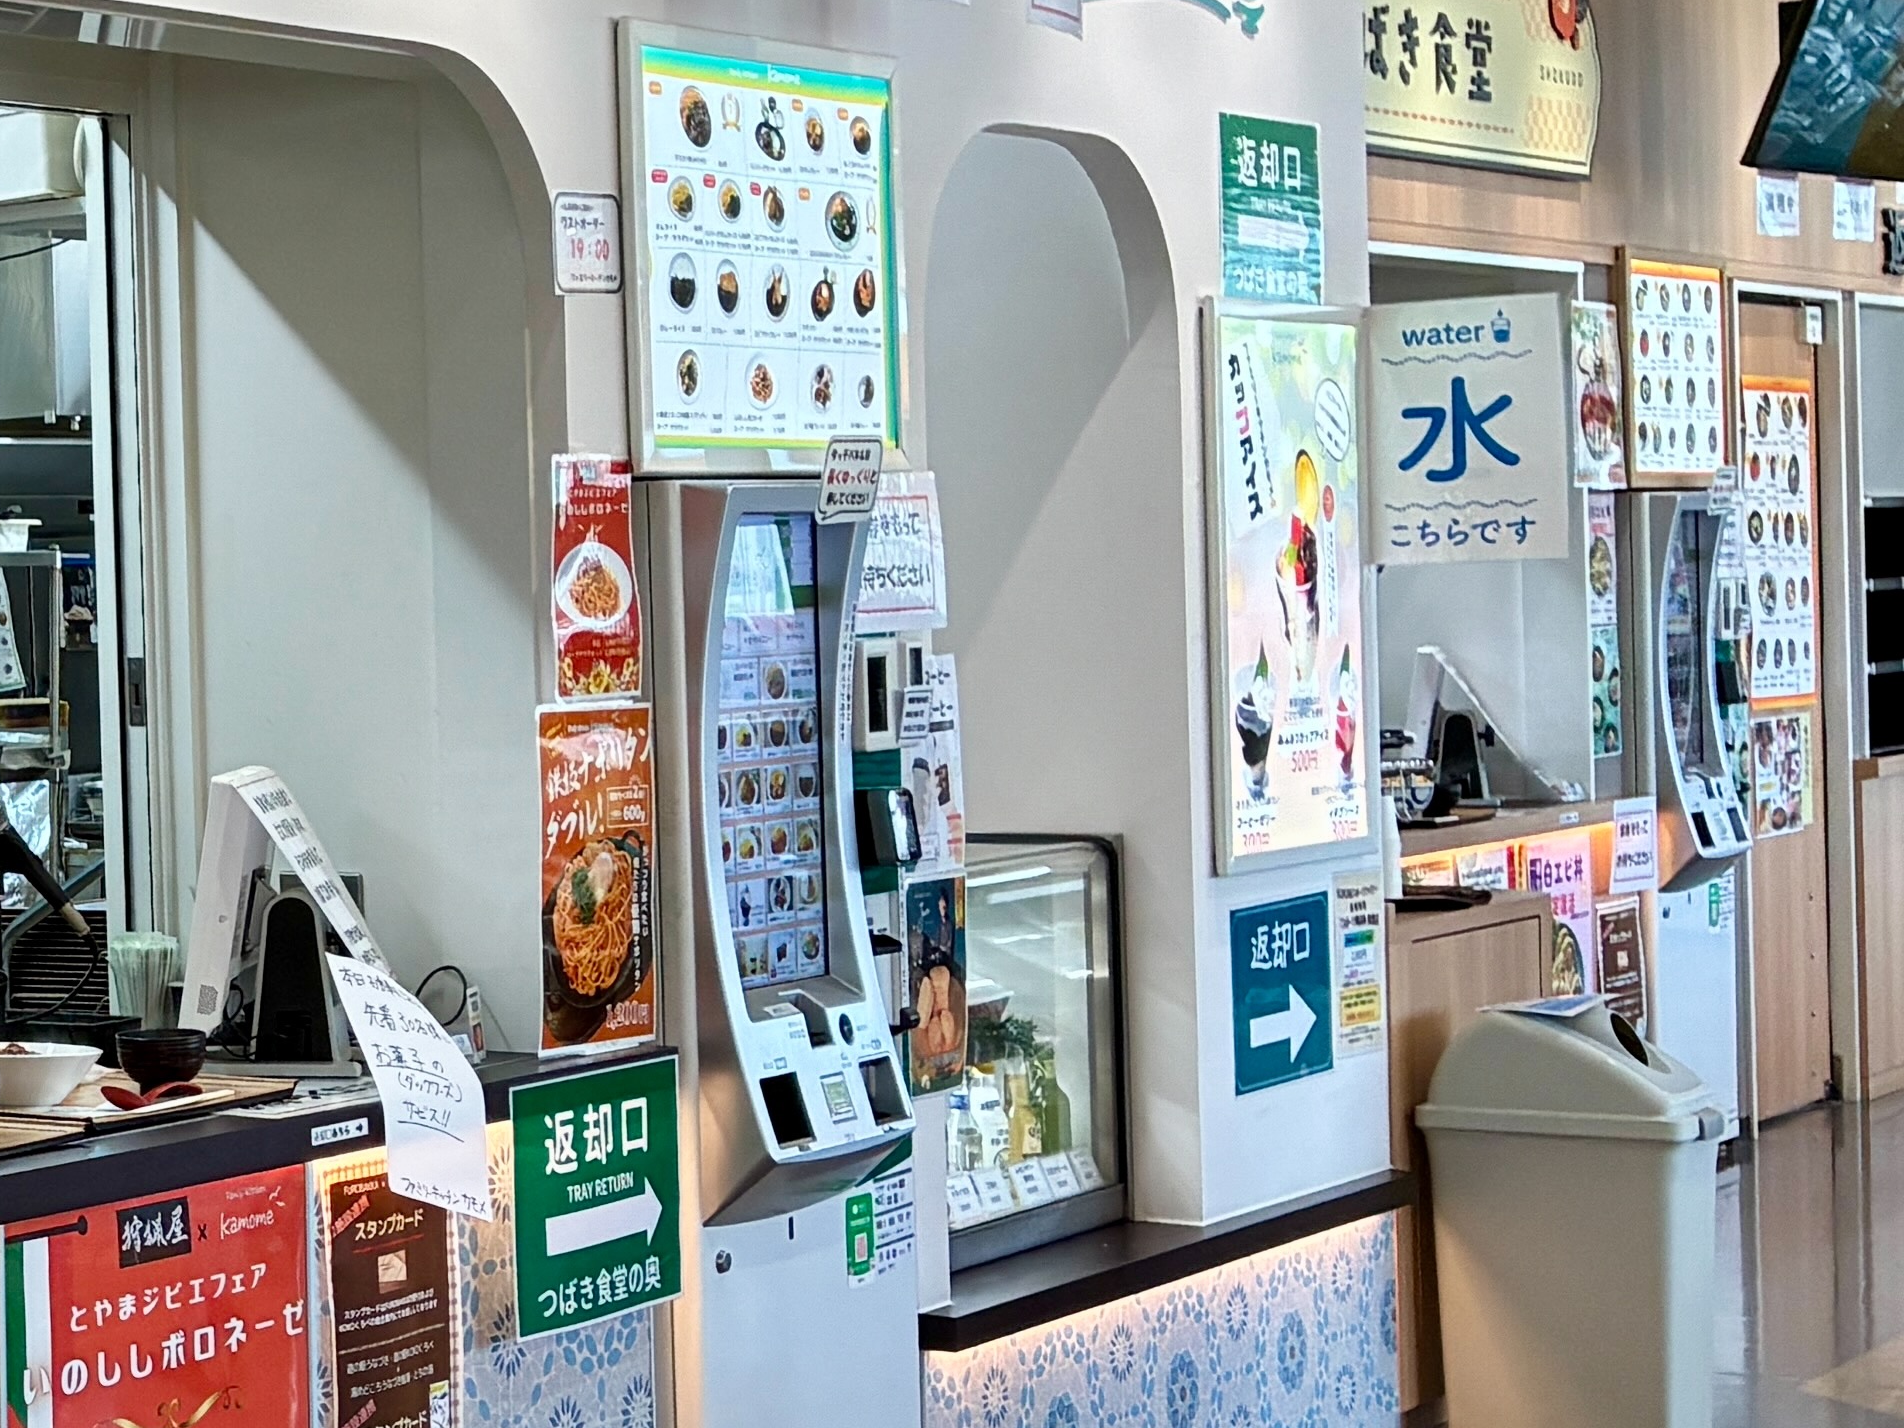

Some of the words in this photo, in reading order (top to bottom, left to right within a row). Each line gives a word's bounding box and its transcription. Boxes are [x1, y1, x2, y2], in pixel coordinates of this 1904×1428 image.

[1230, 135, 1301, 192] 返却口
[1401, 322, 1486, 348] water
[1399, 375, 1522, 483] 水
[1390, 515, 1537, 547] こちらです
[1250, 921, 1310, 969] 返却口
[543, 1094, 649, 1171] 返却口
[566, 1178, 597, 1203] TRAY
[597, 1171, 634, 1198] RETURN
[220, 1210, 275, 1240] kamome
[354, 1208, 424, 1242] スタンプカード
[69, 1261, 270, 1335] とやまジビエフェア
[537, 1255, 664, 1319] つばき食堂の奥
[24, 1298, 305, 1409] いのししボロネーゼ
